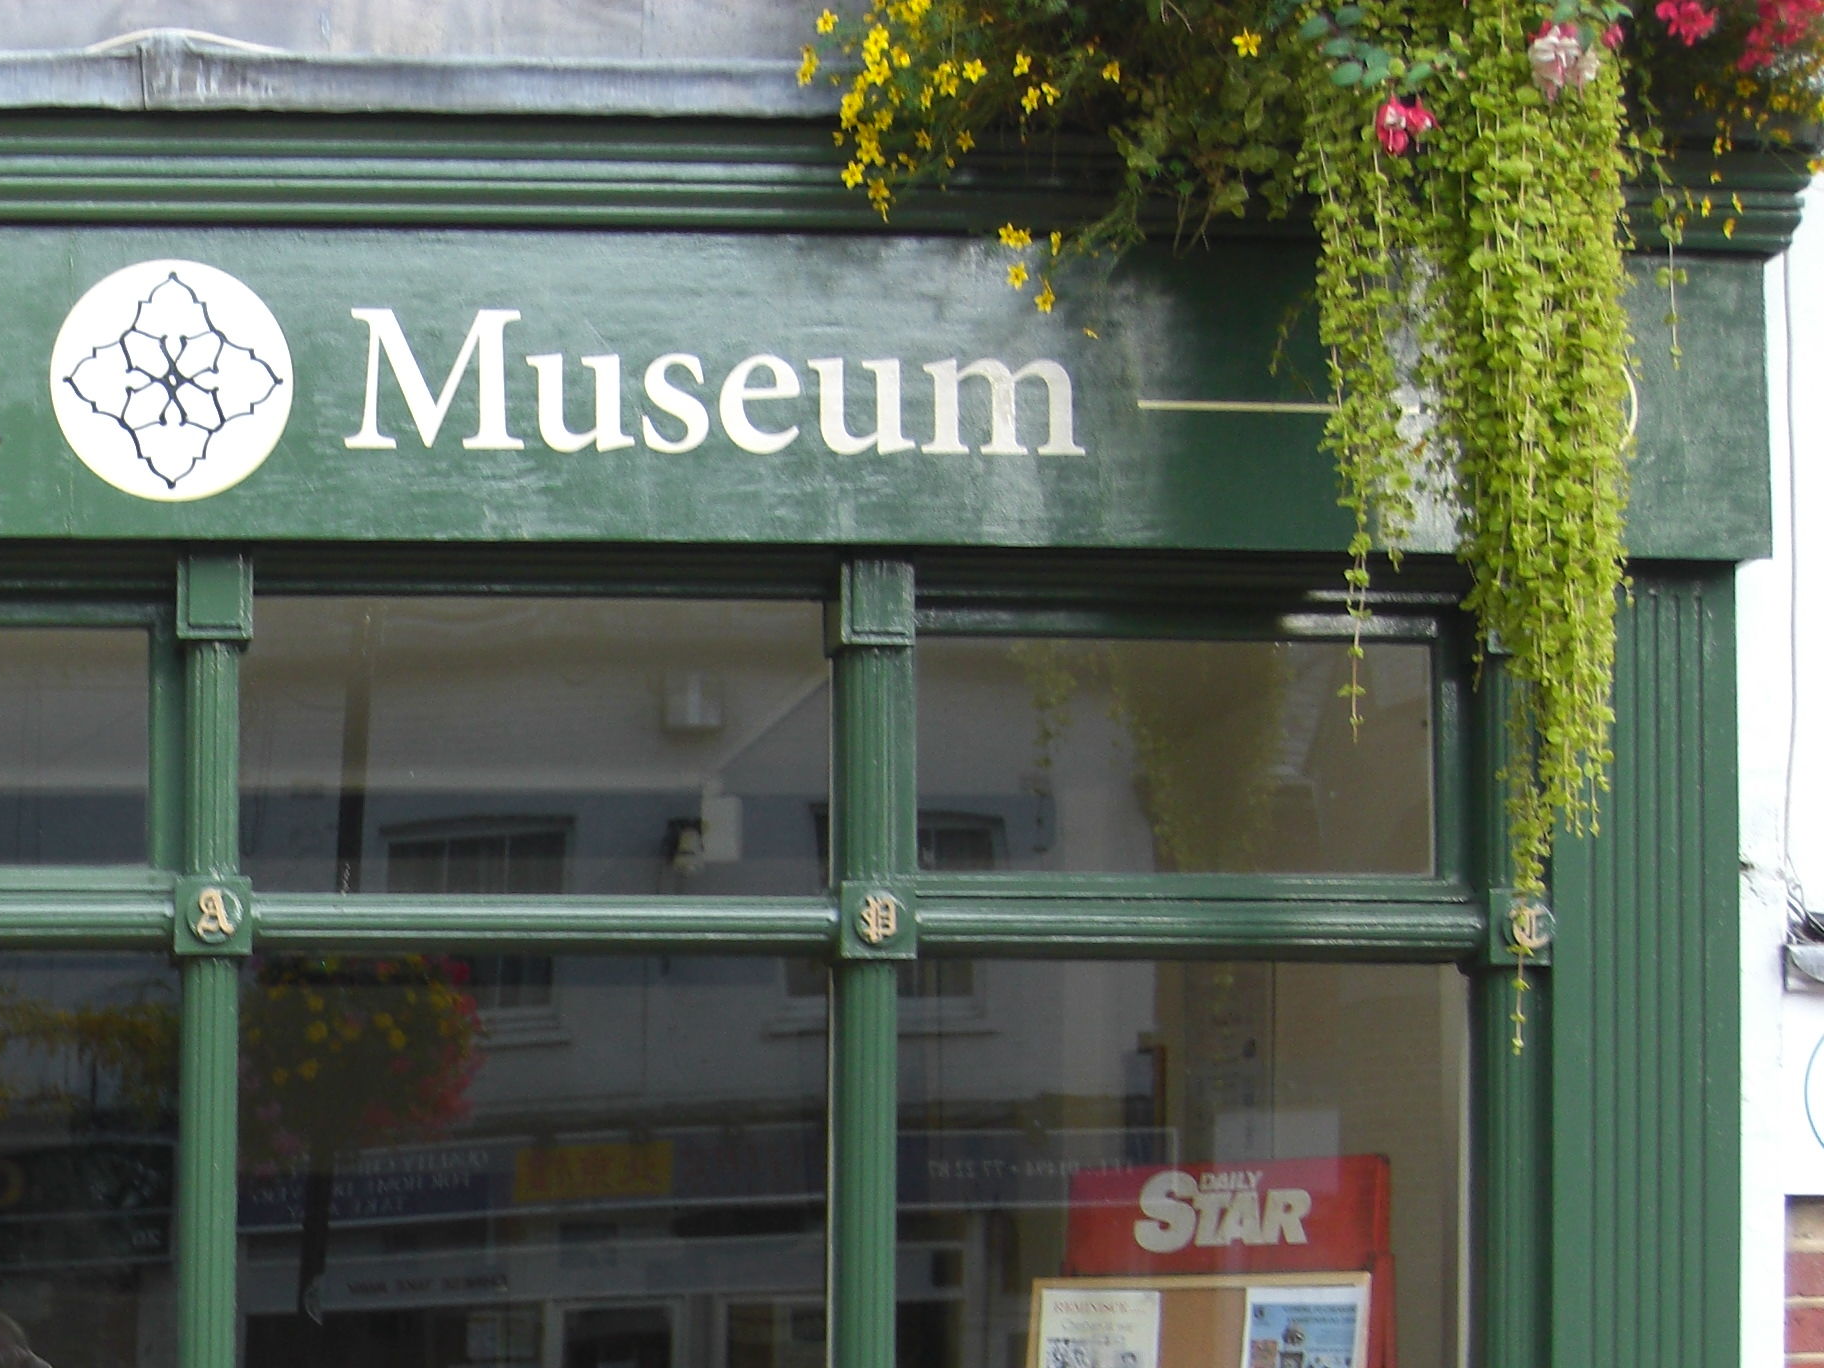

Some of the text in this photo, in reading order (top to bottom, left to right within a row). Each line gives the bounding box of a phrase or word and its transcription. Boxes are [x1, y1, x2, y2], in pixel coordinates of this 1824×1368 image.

[344, 307, 1086, 456] Museum
[1133, 1170, 1312, 1254] STAR
[1199, 1170, 1264, 1192] DAILY
